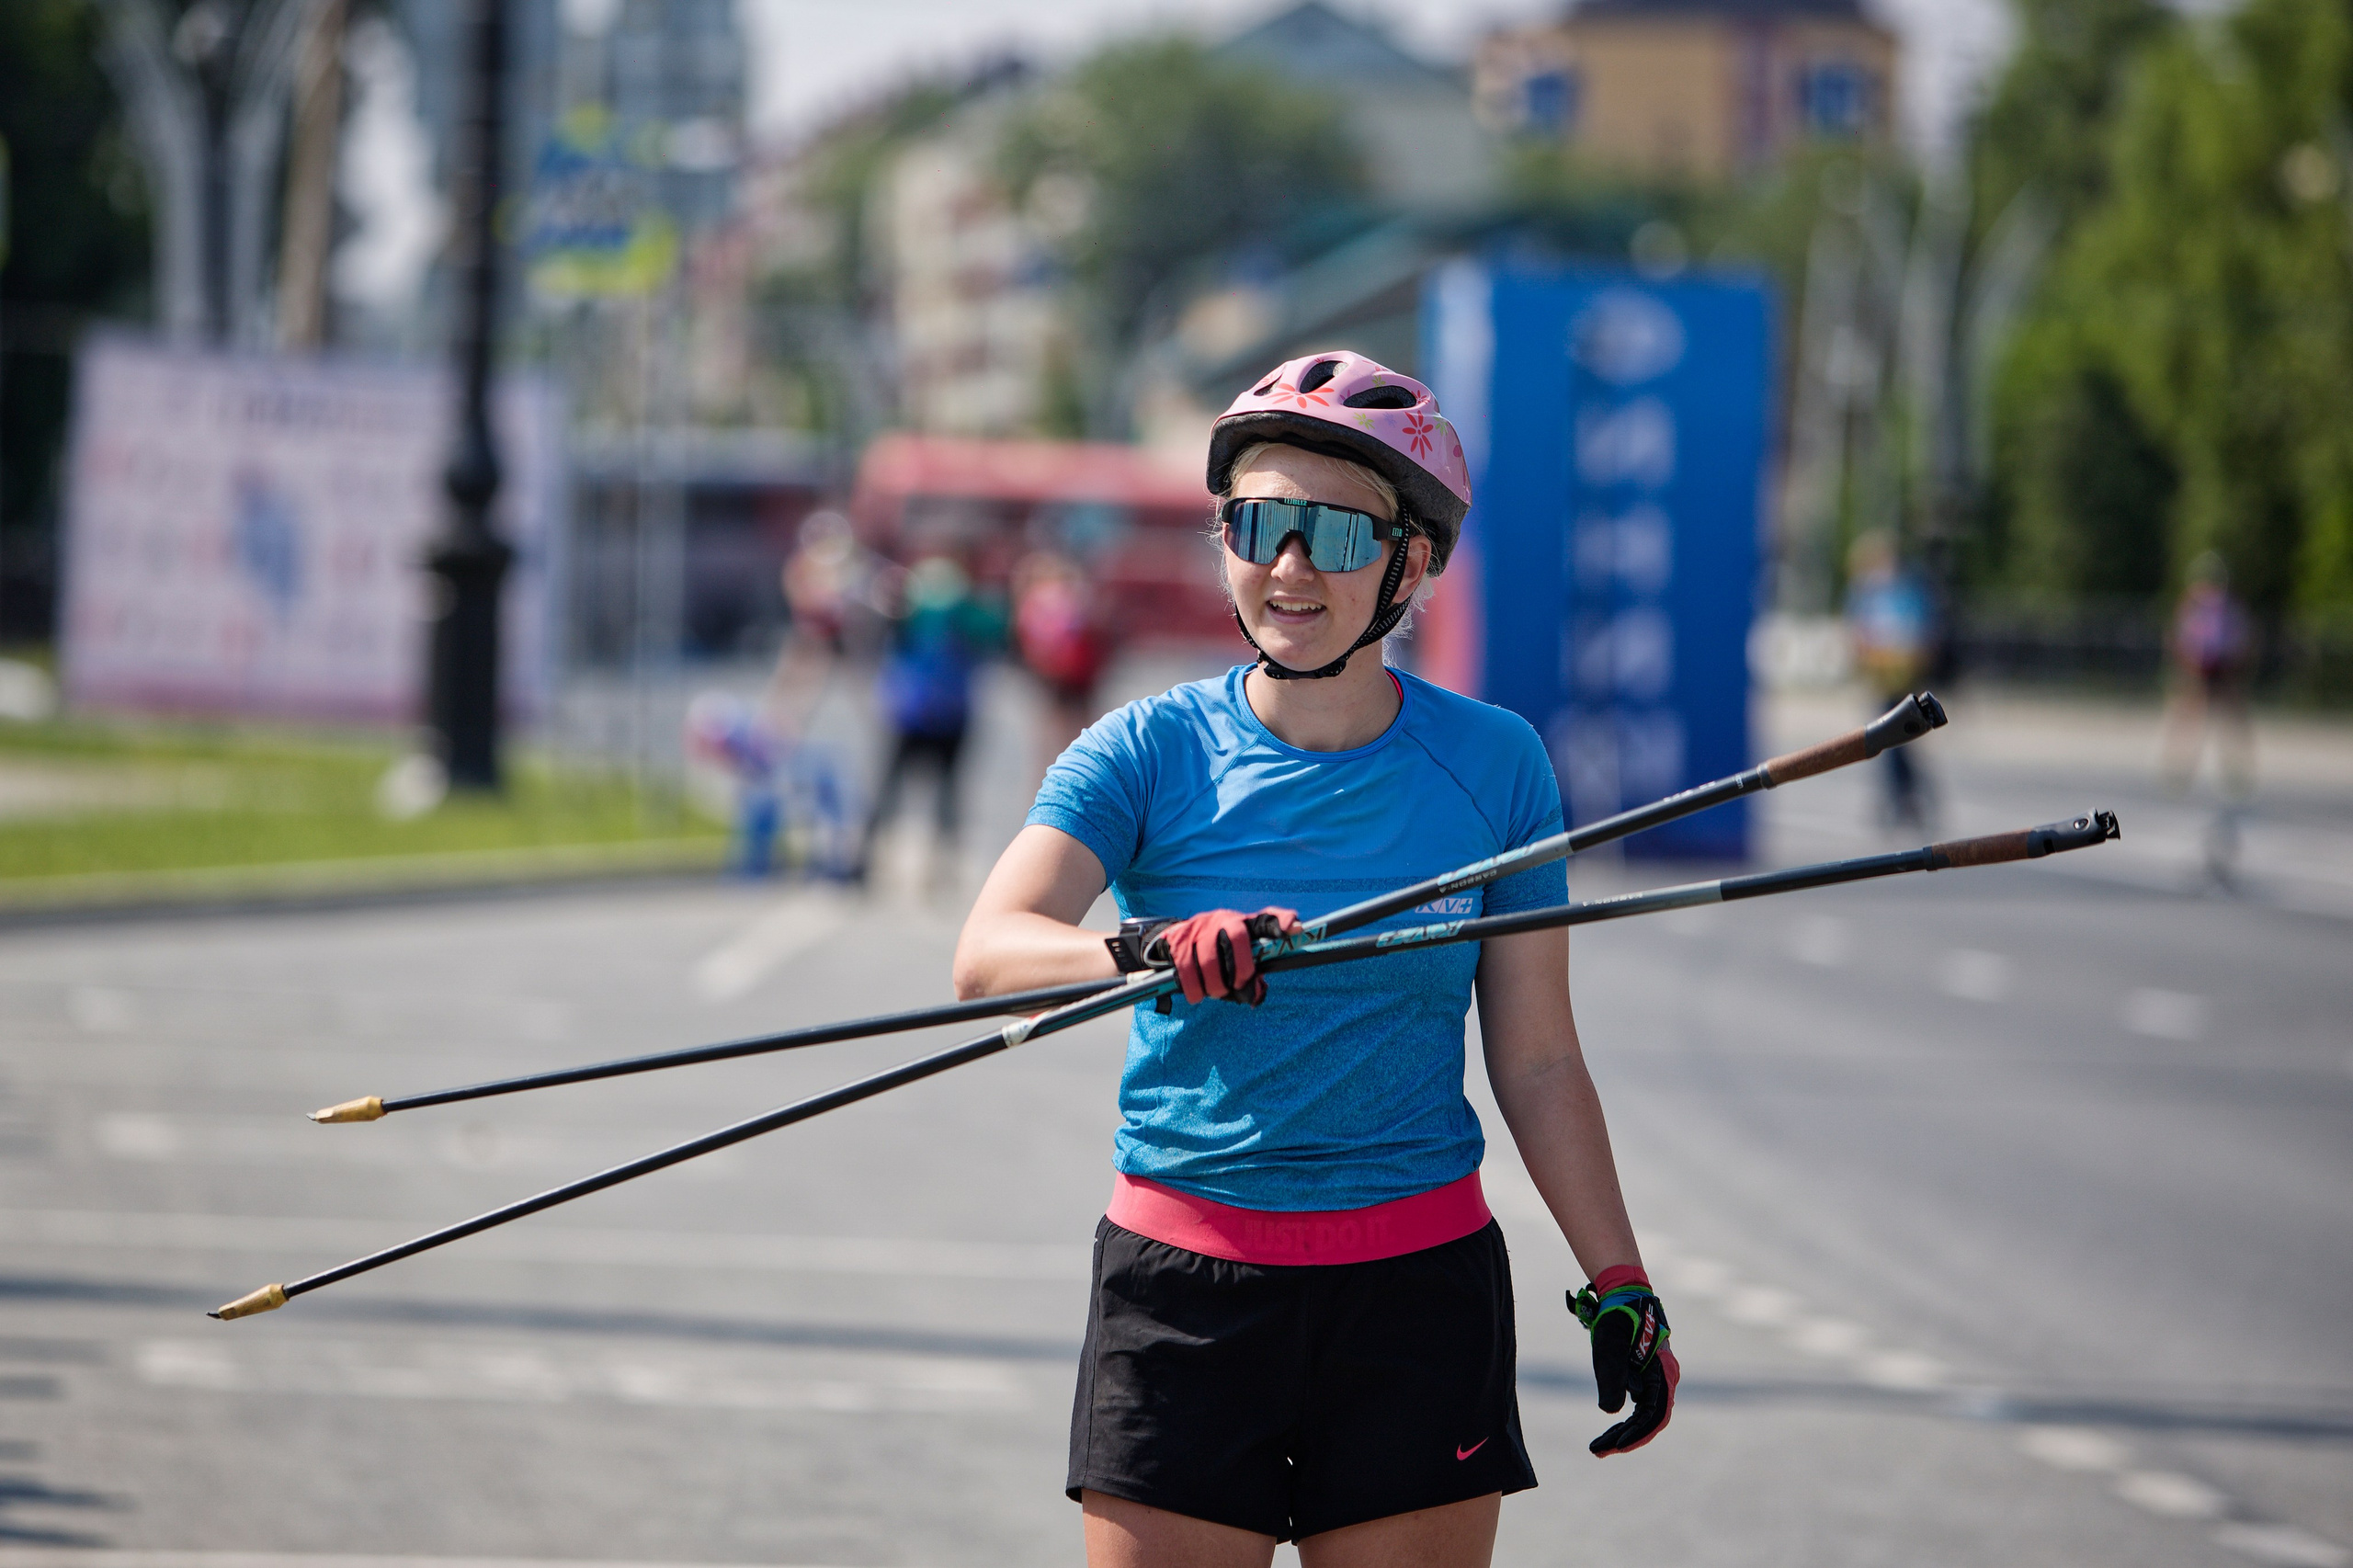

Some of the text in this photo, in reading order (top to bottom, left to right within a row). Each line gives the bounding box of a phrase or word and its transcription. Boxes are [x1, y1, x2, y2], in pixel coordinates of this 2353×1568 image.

[1238, 1212, 1392, 1253] JUST DO IT
[1638, 1311, 1655, 1357] KV+
